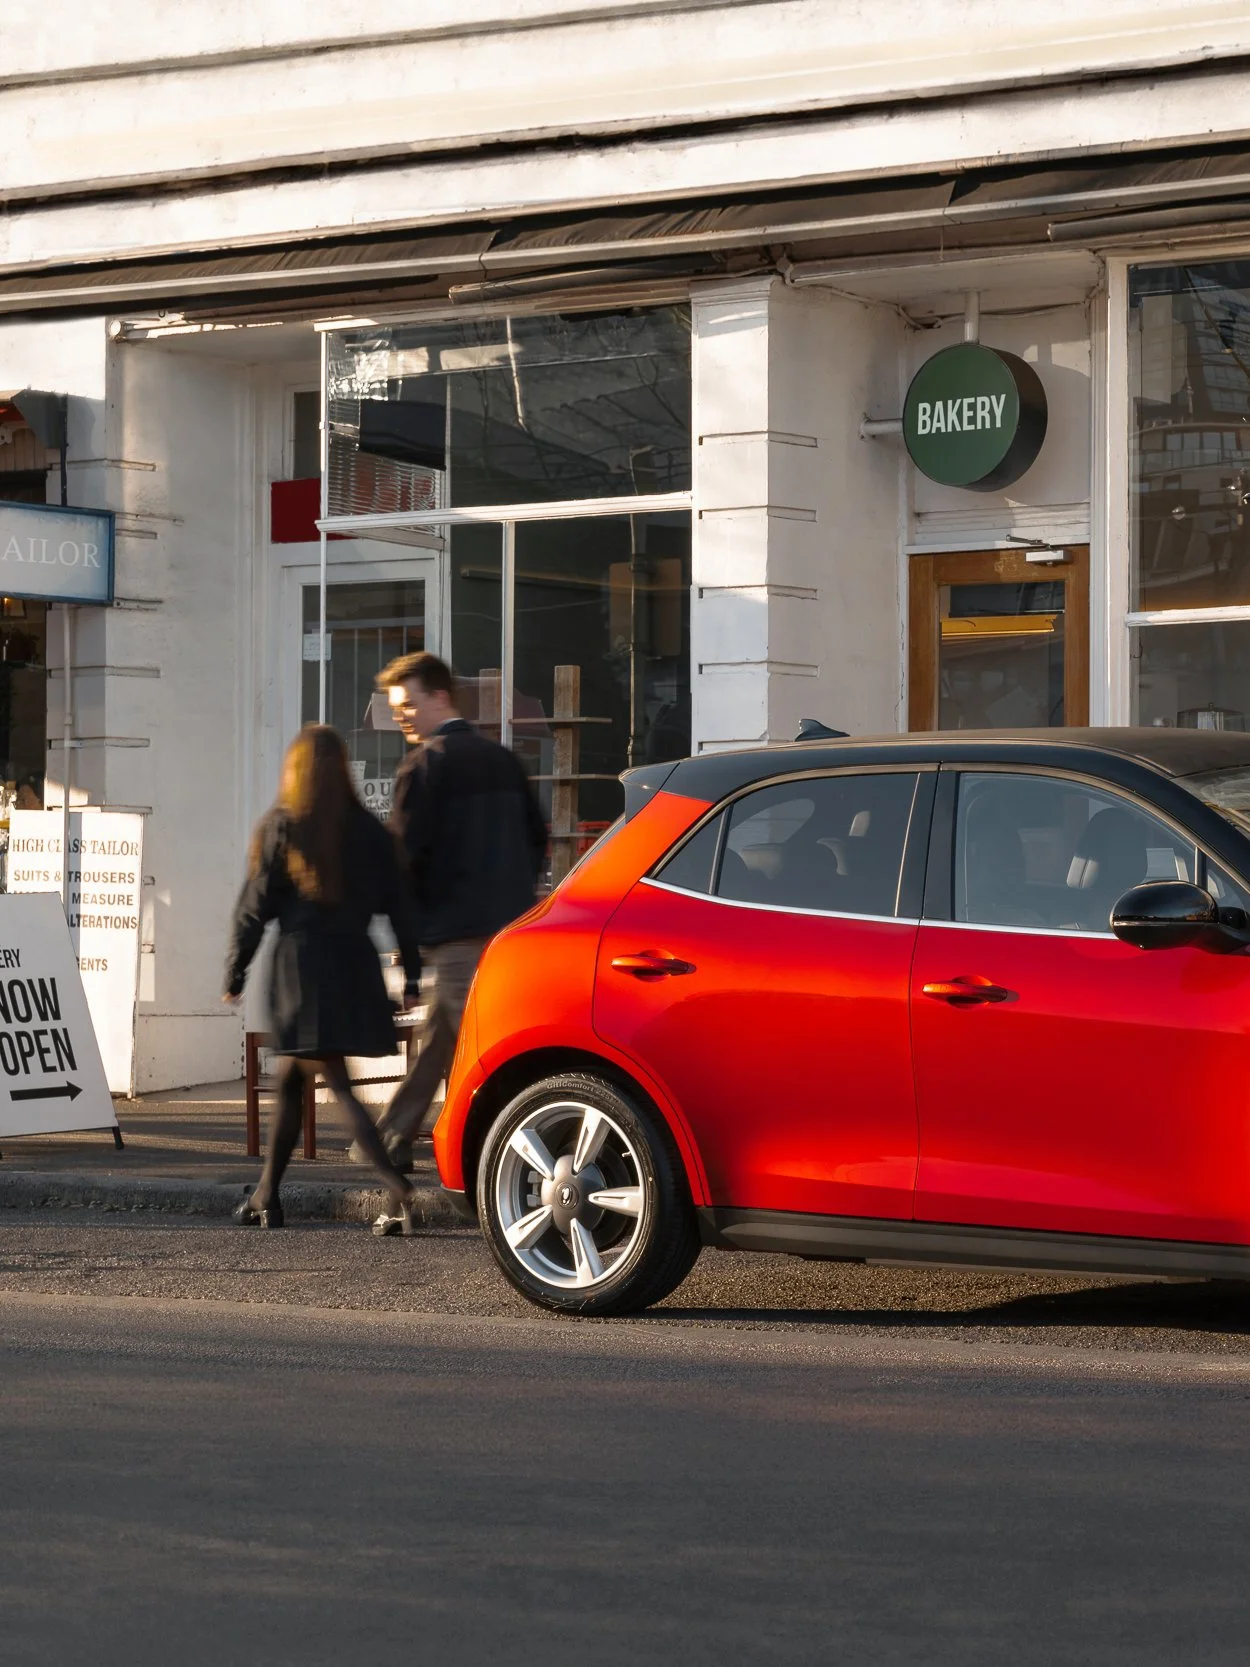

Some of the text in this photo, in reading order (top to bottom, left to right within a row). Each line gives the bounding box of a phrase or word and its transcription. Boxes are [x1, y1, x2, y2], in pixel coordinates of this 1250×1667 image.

[917, 393, 1006, 435] BAKERY
[12, 838, 139, 856] HIGH CLSS TAILOR
[13, 870, 135, 884] SUITS & TROUSERS
[72, 892, 134, 906] MEASURE
[76, 957, 108, 972] ENTS
[0, 1027, 78, 1076] OPEN
